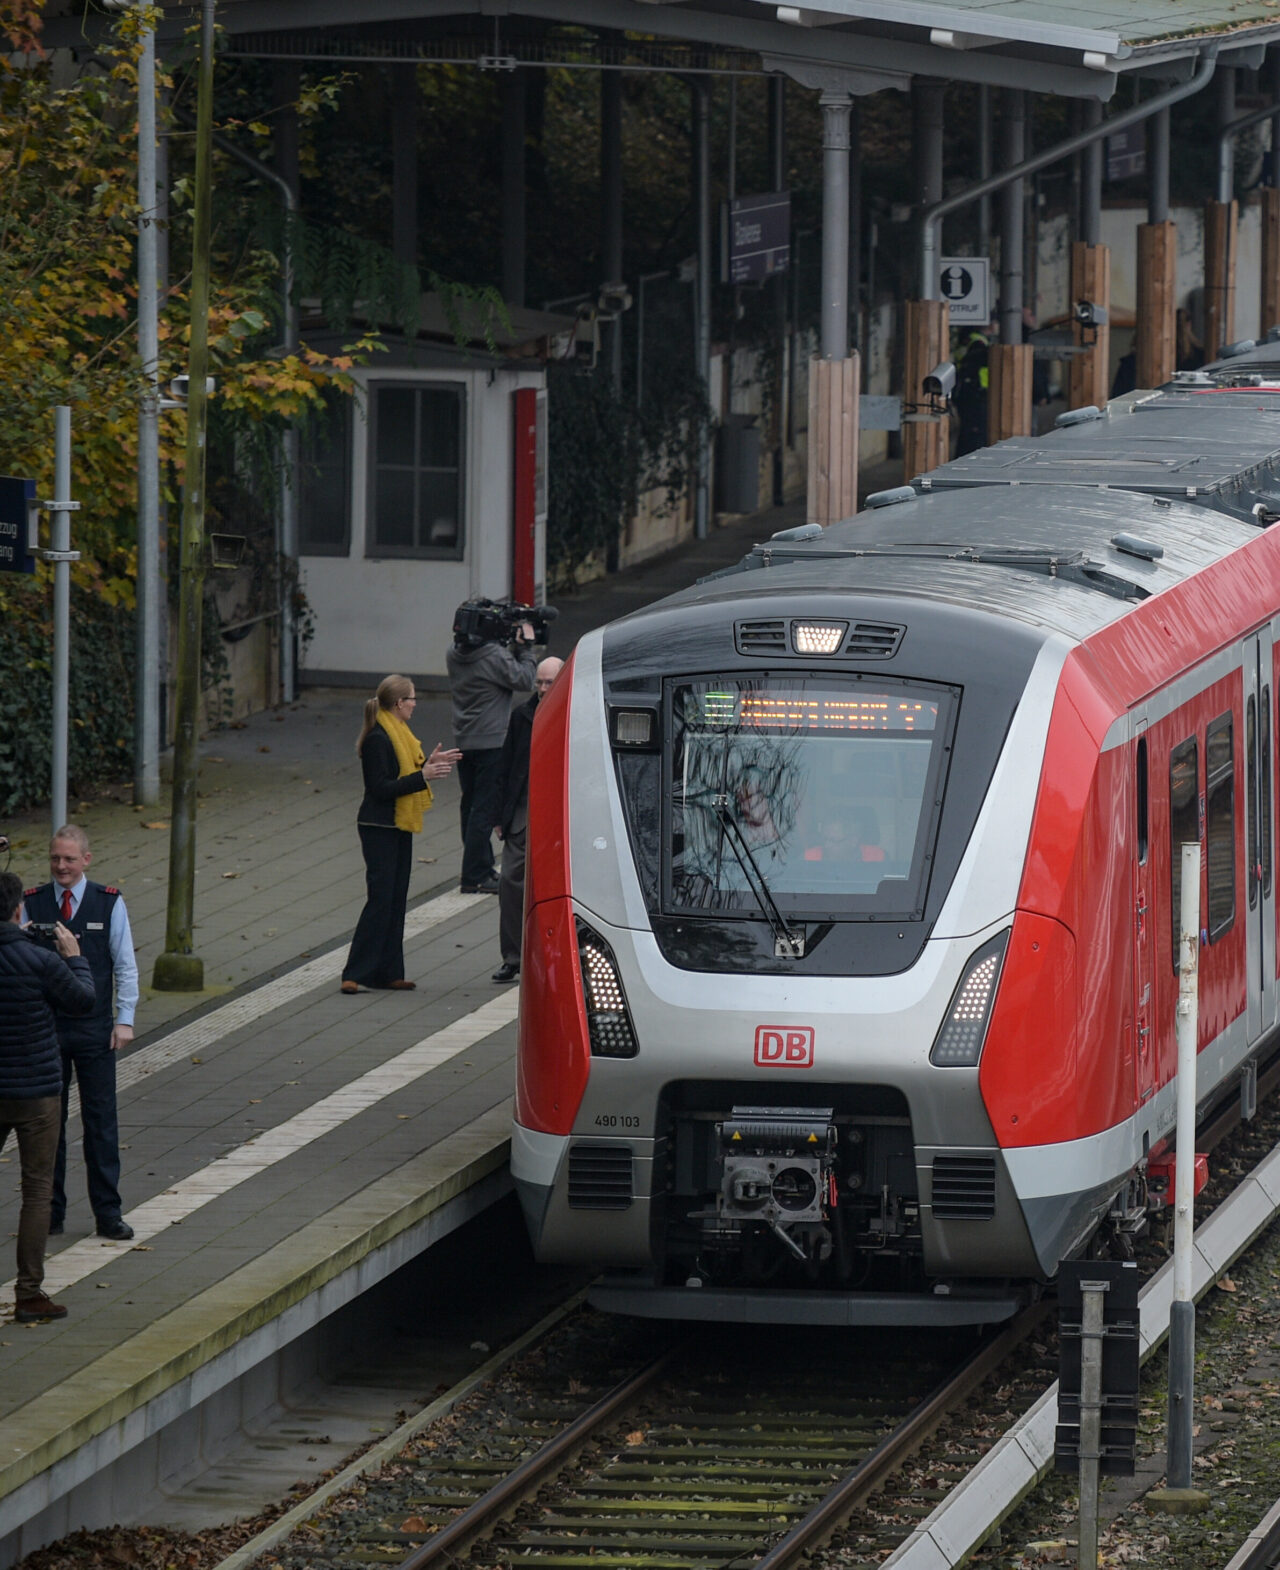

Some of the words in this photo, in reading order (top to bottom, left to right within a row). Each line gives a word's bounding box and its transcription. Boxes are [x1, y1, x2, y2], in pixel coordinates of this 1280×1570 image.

[762, 1032, 807, 1061] DB
[594, 1114, 617, 1127] 490
[620, 1116, 640, 1128] 103
